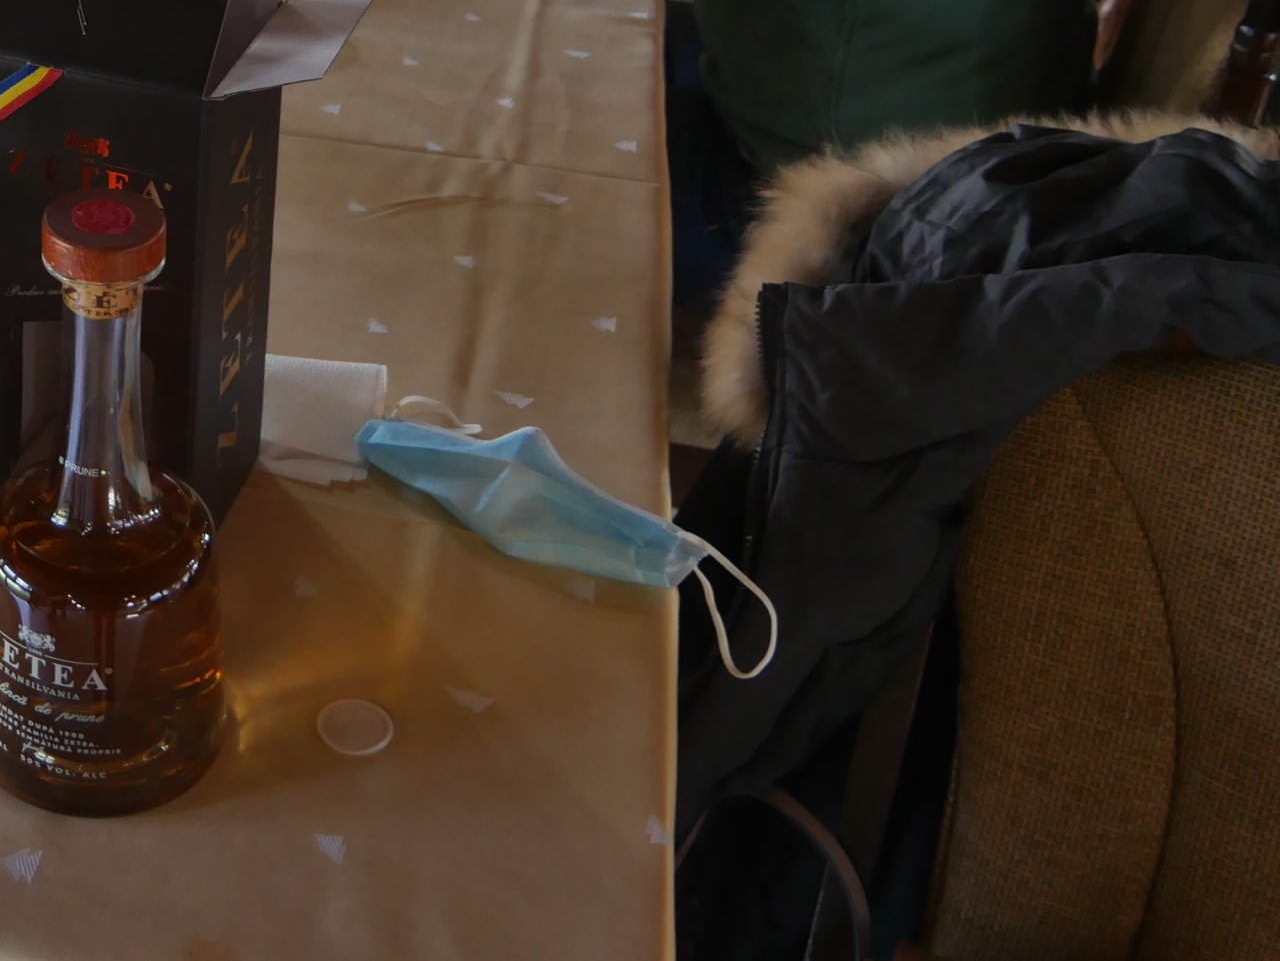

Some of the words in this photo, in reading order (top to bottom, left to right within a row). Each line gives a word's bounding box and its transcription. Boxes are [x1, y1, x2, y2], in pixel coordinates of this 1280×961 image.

[63, 459, 101, 478] PRUNE
[34, 702, 53, 715] de
[54, 712, 106, 723] prune
[82, 770, 108, 779] ALC
